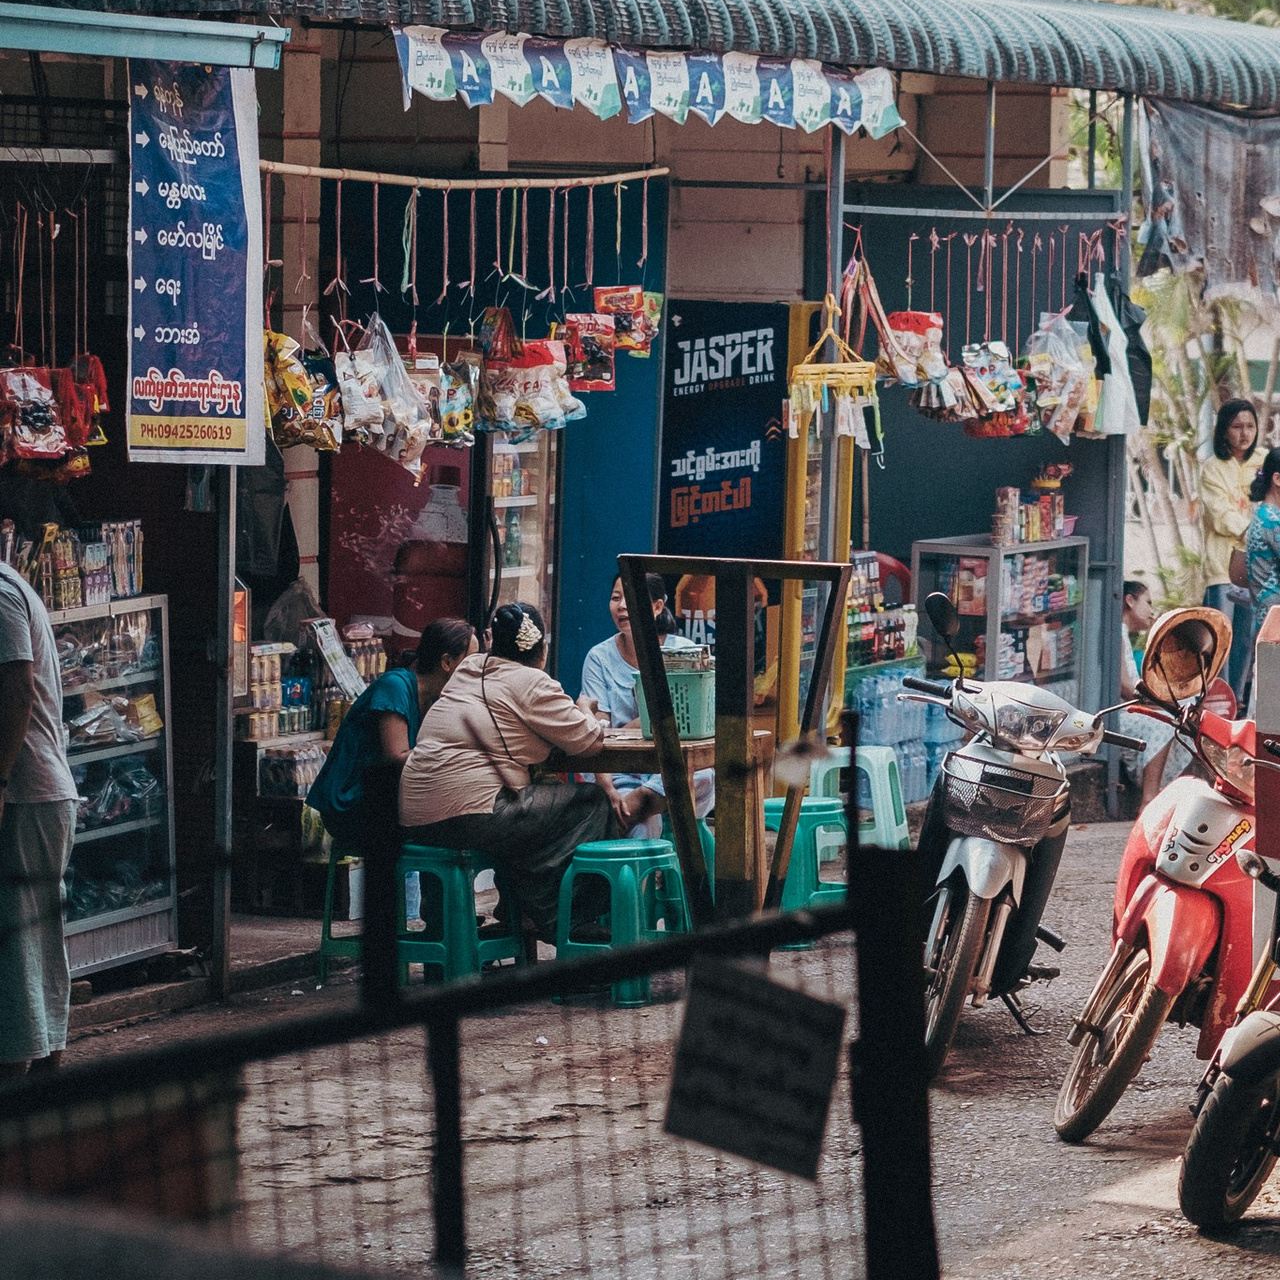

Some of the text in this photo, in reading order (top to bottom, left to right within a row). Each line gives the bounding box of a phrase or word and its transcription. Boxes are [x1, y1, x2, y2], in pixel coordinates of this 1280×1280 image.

[158, 181, 207, 210] မန္တလေး
[157, 220, 225, 261] မော်လမြိုင်
[155, 278, 181, 306] ရေး
[154, 321, 201, 345] ဘားအံ
[674, 327, 774, 386] JASPER
[133, 367, 242, 415] လက်မှတ်အရောင်းဌာန
[673, 372, 775, 397] ENERGY UPGRADE DRINK
